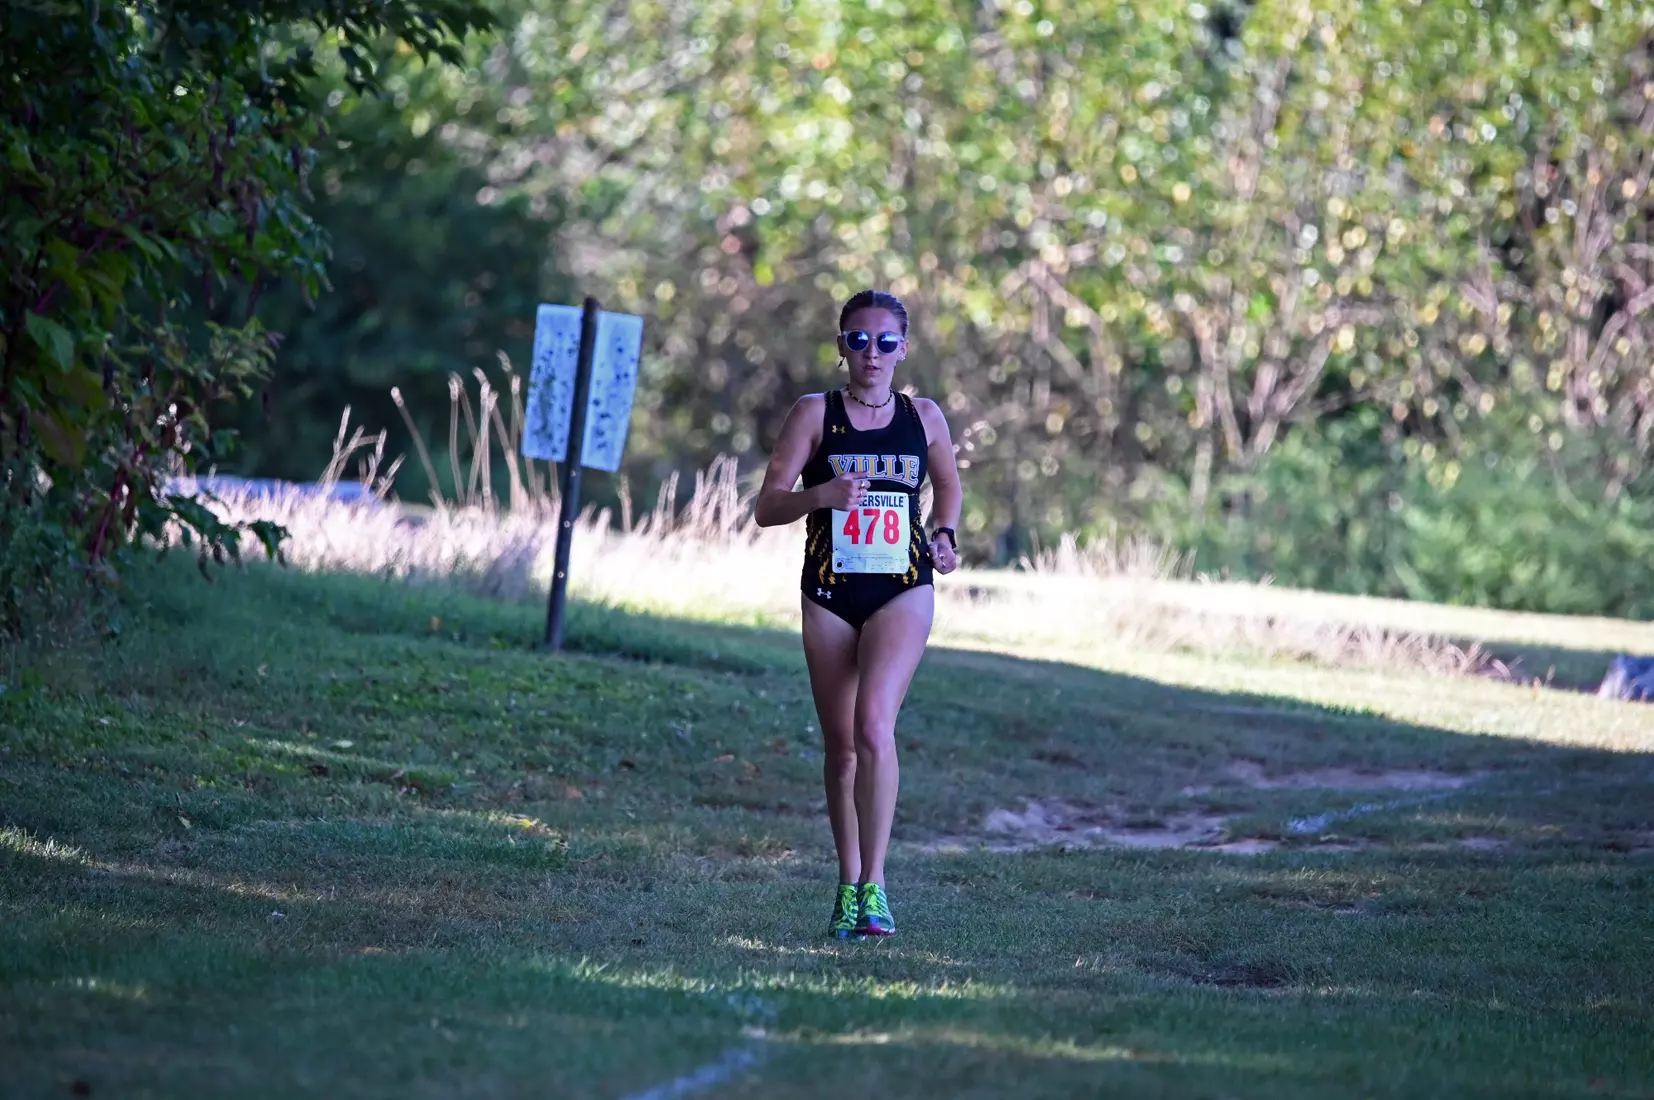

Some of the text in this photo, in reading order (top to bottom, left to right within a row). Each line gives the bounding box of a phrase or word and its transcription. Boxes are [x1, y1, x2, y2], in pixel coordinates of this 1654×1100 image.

[828, 454, 919, 488] VILLE
[859, 495, 904, 507] ERSVILLE
[843, 509, 900, 544] 478
